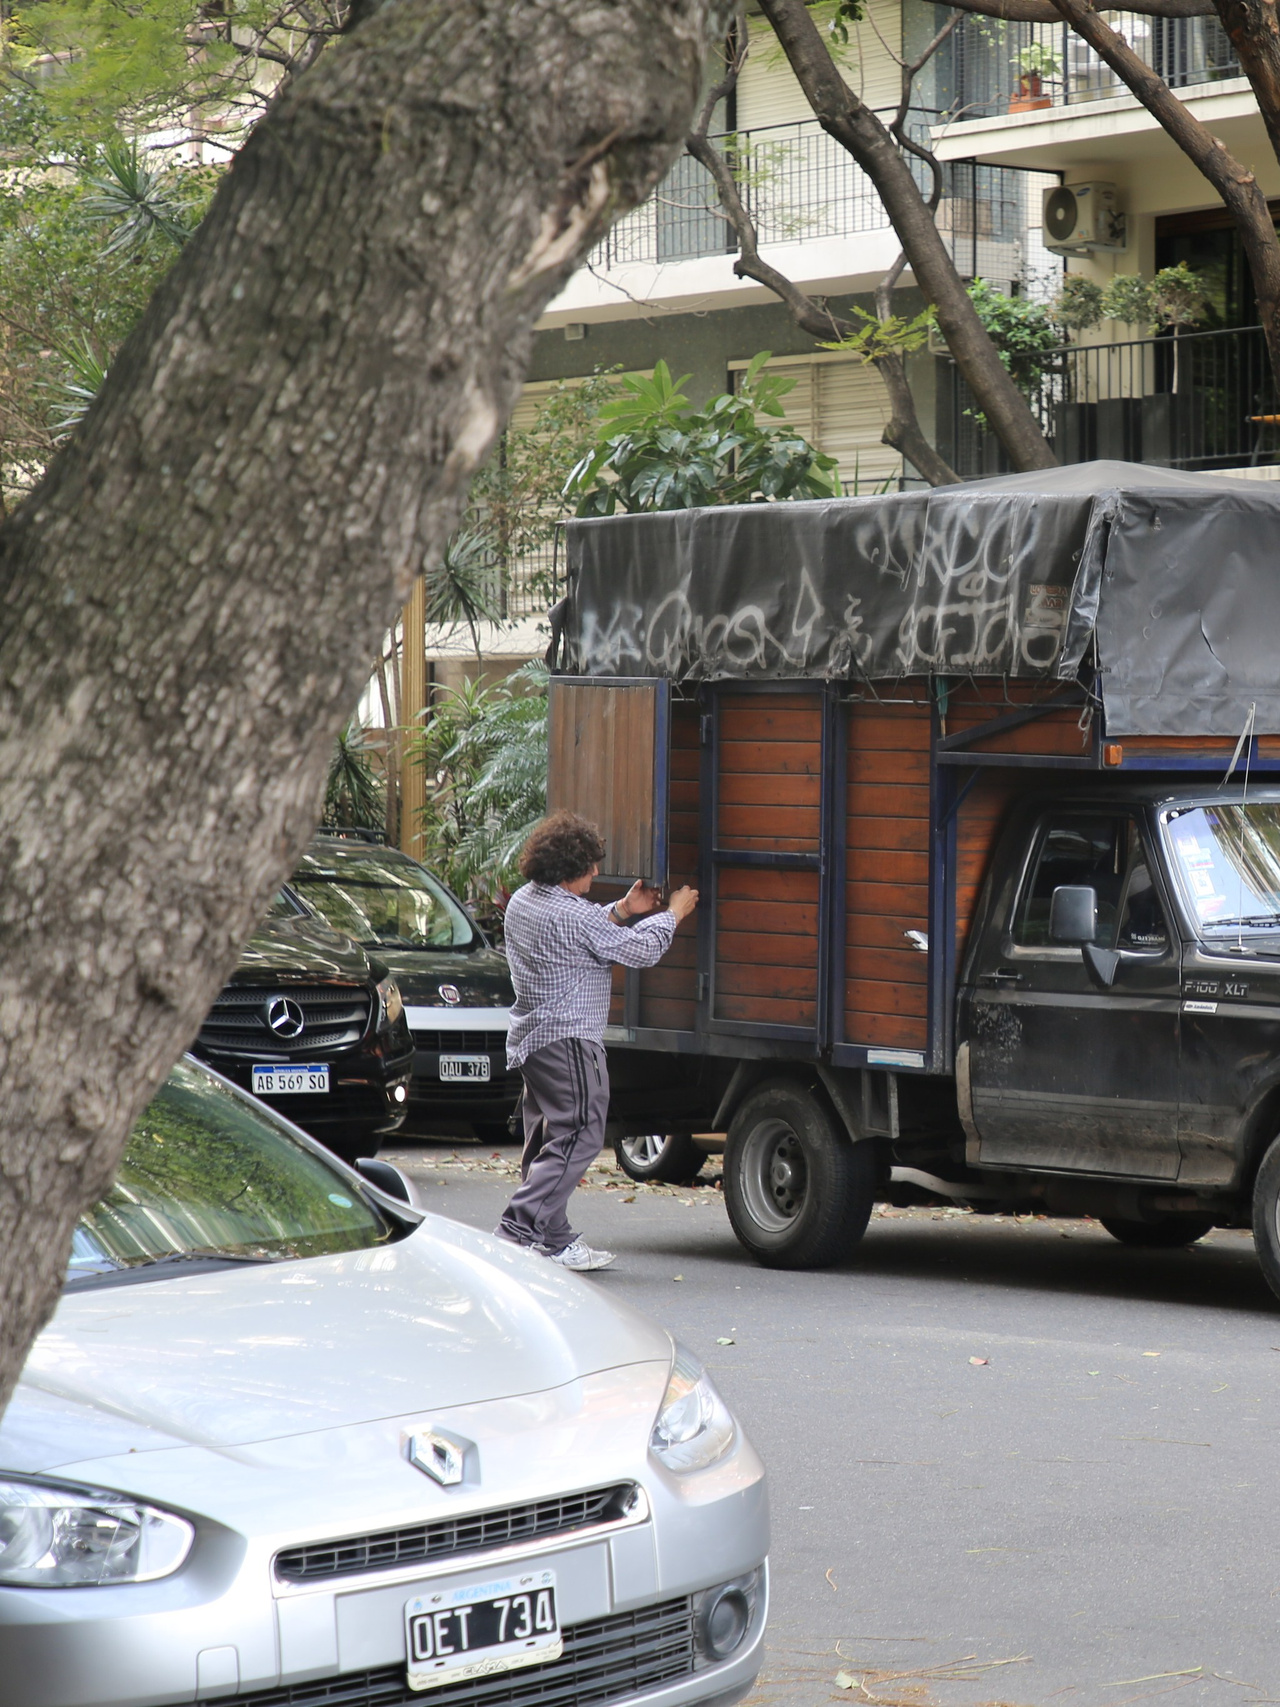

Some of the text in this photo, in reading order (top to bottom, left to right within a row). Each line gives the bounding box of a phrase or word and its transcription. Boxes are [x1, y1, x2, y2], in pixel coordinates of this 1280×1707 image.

[1225, 983, 1248, 996] XLT
[441, 1062, 488, 1076] OAU 378
[257, 1075, 274, 1090] AB
[279, 1075, 303, 1090] 569
[452, 1581, 512, 1601] ARGENTINA
[413, 1589, 554, 1660] OET 734
